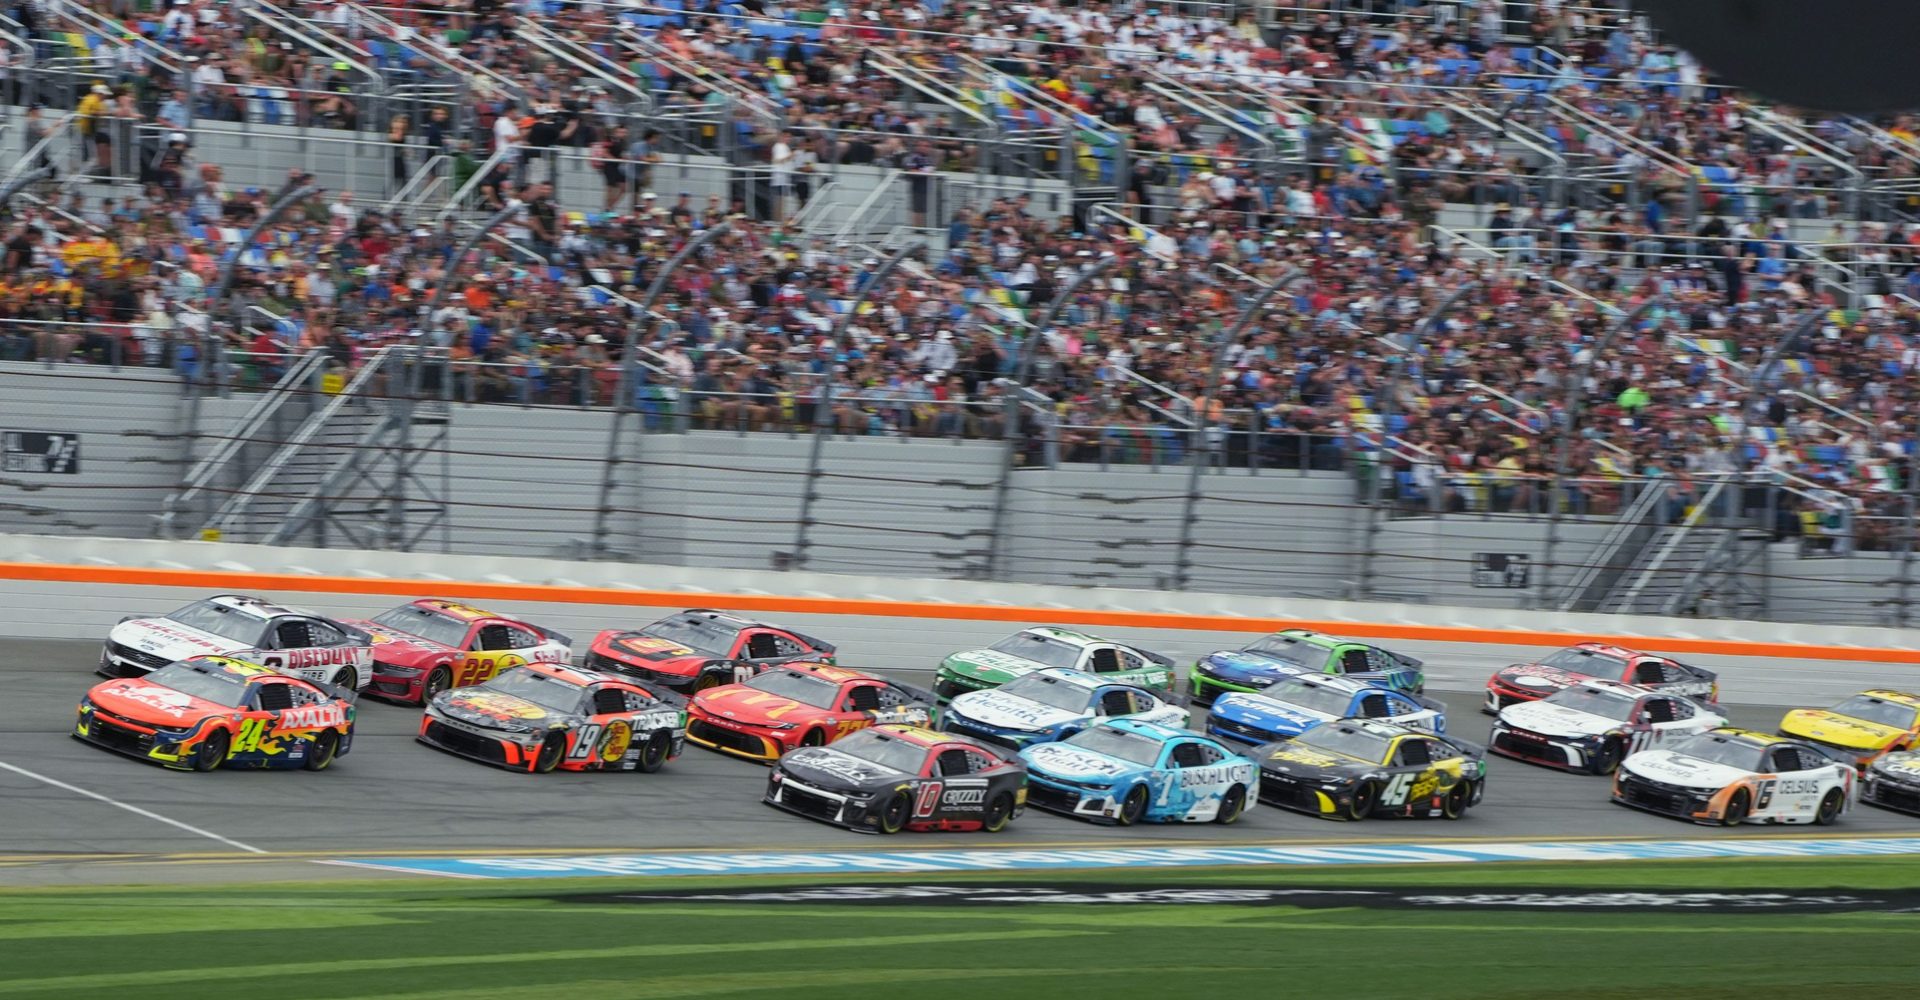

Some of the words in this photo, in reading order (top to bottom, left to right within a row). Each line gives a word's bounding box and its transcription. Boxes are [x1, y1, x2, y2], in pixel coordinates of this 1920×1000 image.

[288, 647, 358, 669] DISCOUNT
[456, 658, 494, 688] 22
[100, 688, 187, 718] AXALTA
[964, 695, 1038, 723] Health
[282, 708, 346, 730] AXALTA
[445, 718, 480, 733] CAMRY
[632, 712, 679, 731] TRACKER
[706, 716, 742, 730] CAMRY
[231, 718, 267, 753] 24
[571, 723, 600, 759] 19
[1624, 731, 1653, 758] 11
[1030, 746, 1124, 776] BUSCH
[1039, 755, 1089, 772] LIGHT
[1640, 761, 1693, 779] CELSIUS
[1181, 768, 1217, 788] BUSCH
[1216, 764, 1254, 784] LIGHT
[1262, 771, 1297, 784] CAMRY
[1778, 780, 1820, 795] CELSIUS
[911, 781, 942, 818] 10
[942, 790, 987, 806] GRIZZLY
[1155, 772, 1175, 807] 1
[1379, 773, 1416, 806] 45
[1756, 780, 1776, 810] 16
